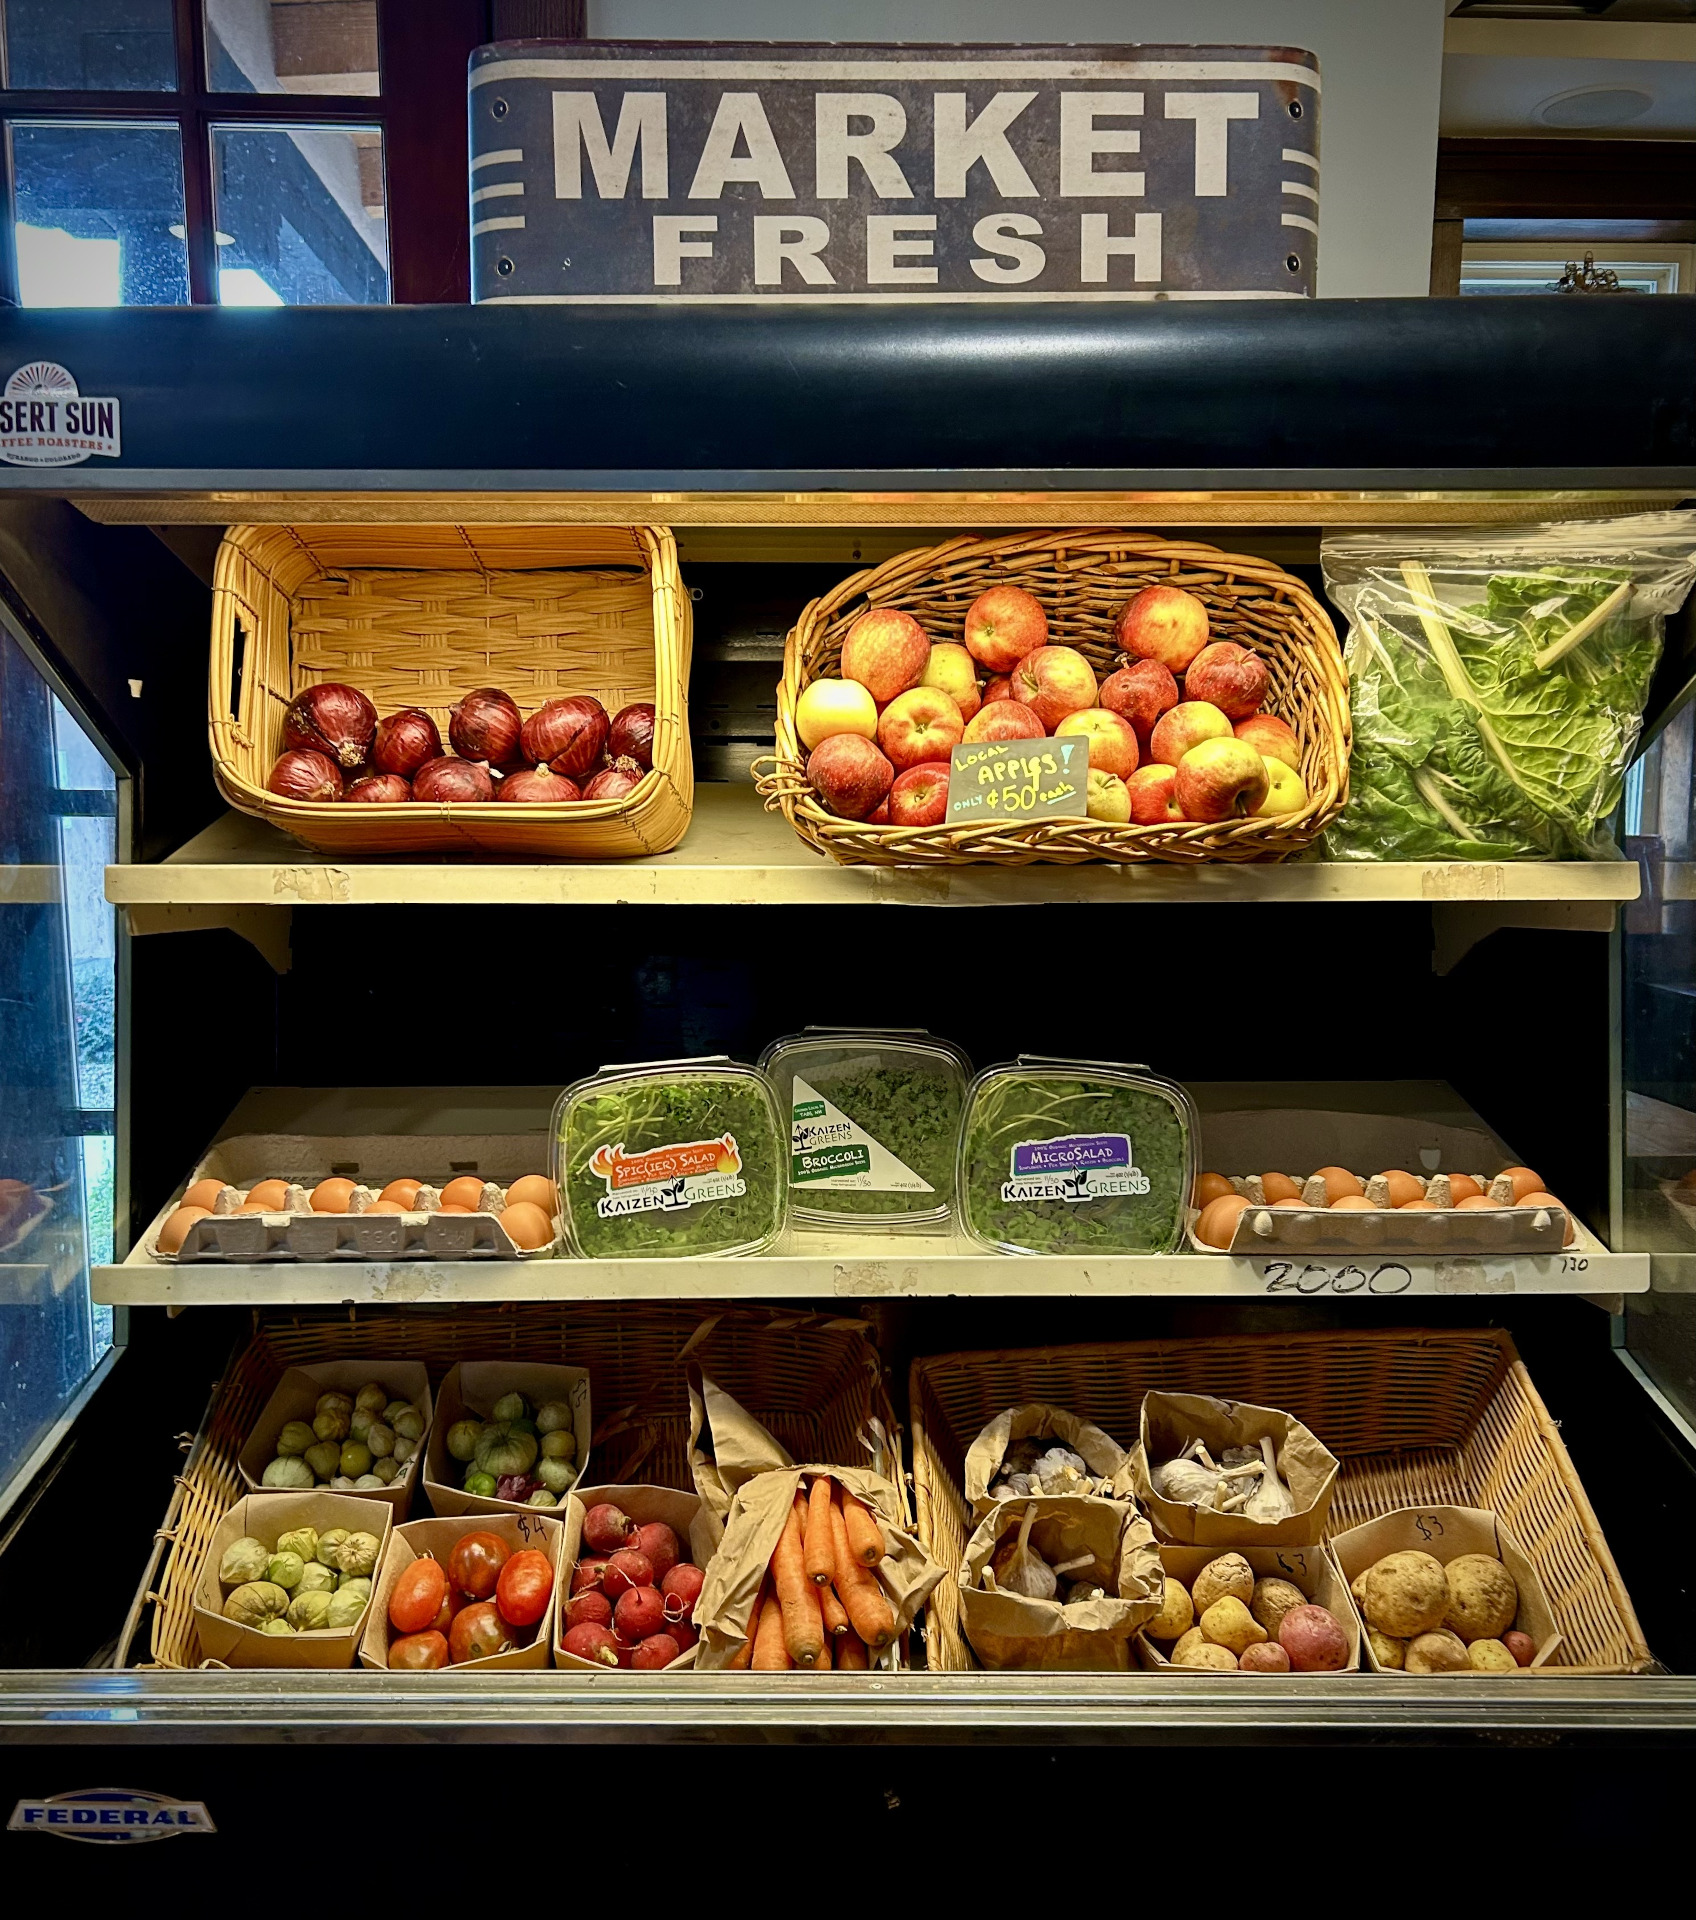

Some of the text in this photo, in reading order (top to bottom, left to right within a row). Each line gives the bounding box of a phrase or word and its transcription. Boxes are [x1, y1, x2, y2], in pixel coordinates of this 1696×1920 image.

[551, 90, 1260, 200] MARKET
[652, 212, 1162, 286] FRESH
[0, 401, 114, 439] SERT SUN
[38, 438, 103, 450] ROASTERS
[955, 745, 1009, 772] LOCAL
[953, 795, 982, 812] ONLY
[809, 1122, 851, 1137] KAIZEN
[809, 1131, 853, 1146] GREENS
[802, 1149, 864, 1169] BROCCOLI
[601, 1181, 744, 1215] KAIZEN GREENS
[1004, 1179, 1147, 1199] KAIZEN GREENS
[1263, 1262, 1412, 1295] 2000
[517, 1514, 548, 1543] $4
[1415, 1514, 1444, 1541] $3
[23, 1808, 197, 1825] FEDERAL
